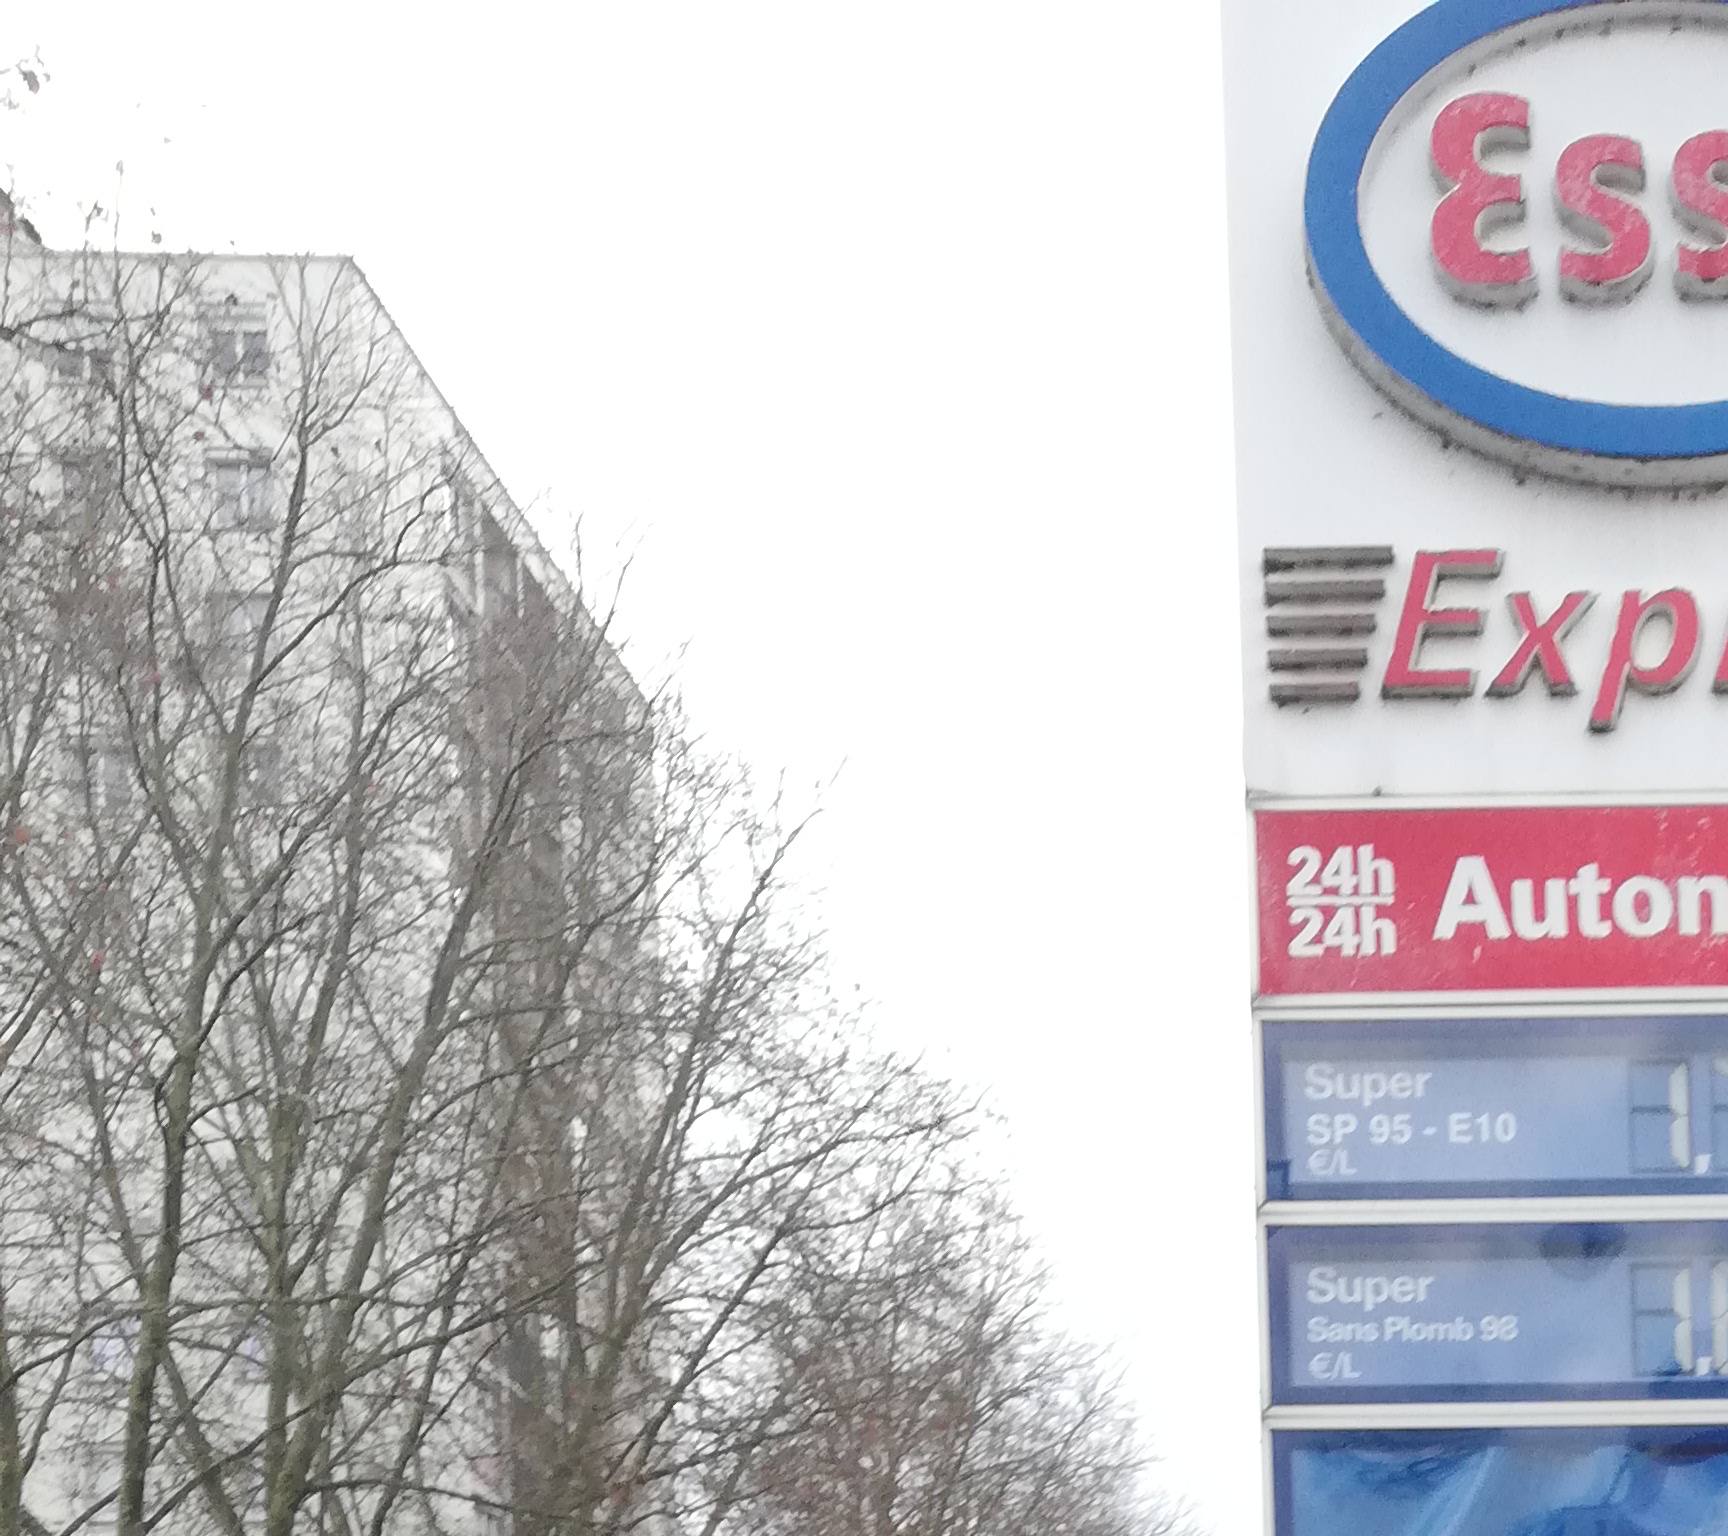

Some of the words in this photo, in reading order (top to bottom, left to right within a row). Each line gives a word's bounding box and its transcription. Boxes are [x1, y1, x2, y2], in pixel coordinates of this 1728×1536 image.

[1286, 843, 1395, 896] 24h
[1287, 905, 1397, 958] 24h
[1304, 1061, 1432, 1108] Super
[1306, 1112, 1359, 1145] SP
[1369, 1113, 1413, 1145] 95
[1449, 1111, 1517, 1143] E10
[1307, 1266, 1435, 1311] Super
[1307, 1316, 1380, 1342] Sans
[1383, 1315, 1475, 1342] Plomb
[1480, 1315, 1519, 1341] 98
